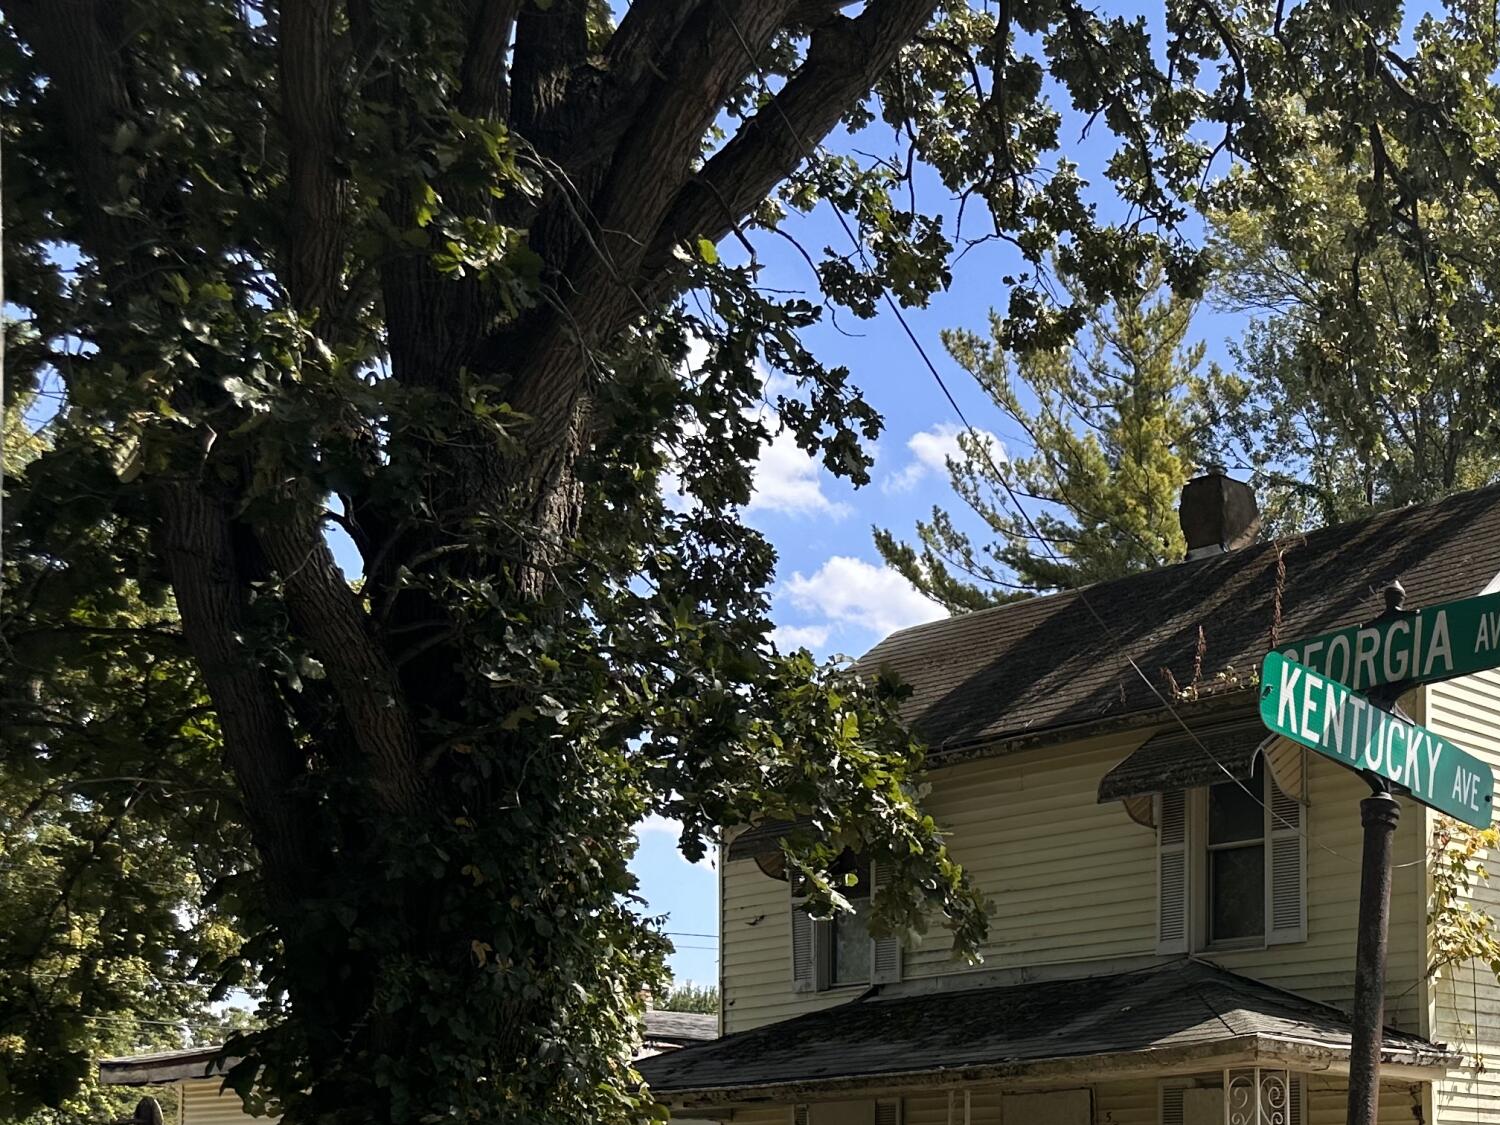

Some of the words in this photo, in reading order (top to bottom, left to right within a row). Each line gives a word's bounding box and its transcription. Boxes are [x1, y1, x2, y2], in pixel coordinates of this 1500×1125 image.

[1283, 609, 1454, 691] ORGIA
[1277, 661, 1443, 800] KENTUCKY
[1451, 765, 1481, 812] AVE
